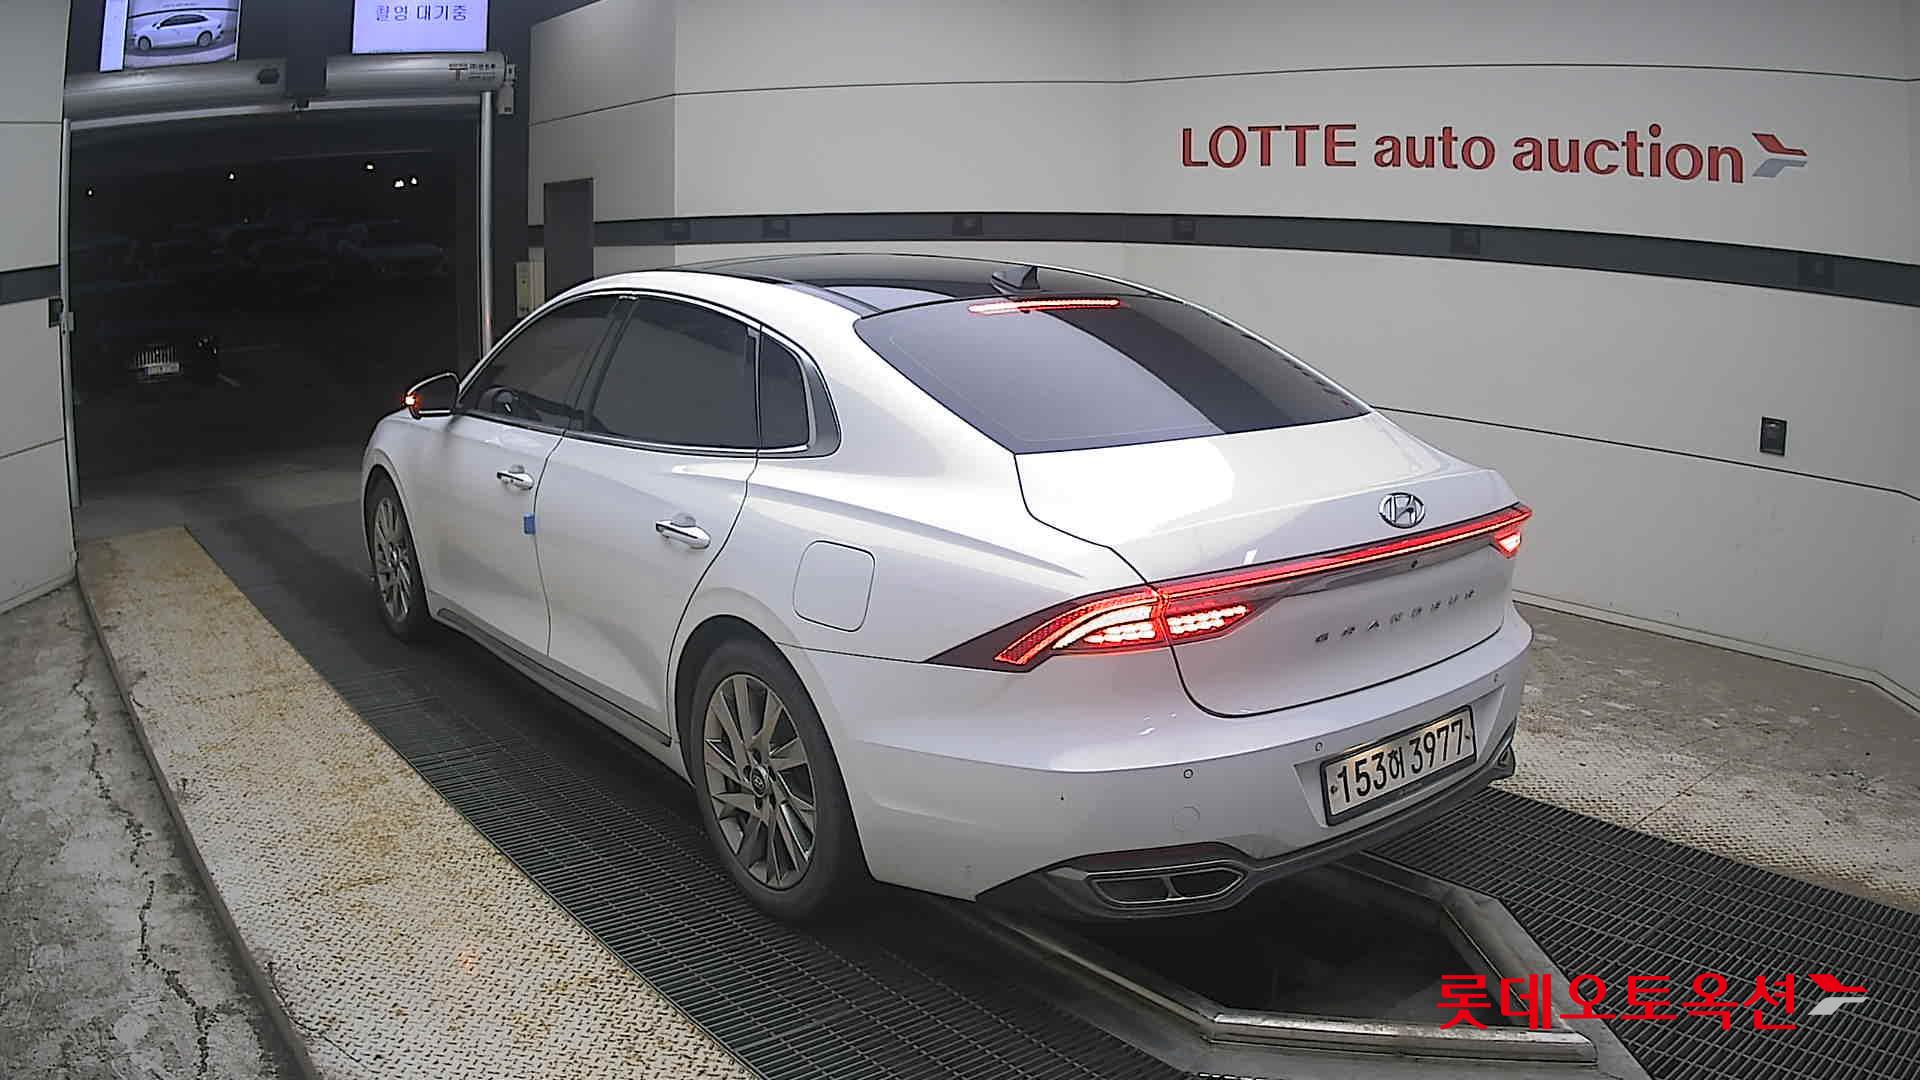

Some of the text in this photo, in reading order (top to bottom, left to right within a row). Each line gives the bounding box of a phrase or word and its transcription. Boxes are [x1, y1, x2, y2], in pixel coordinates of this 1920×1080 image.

[416, 4, 466, 21] 대기중
[1181, 124, 1744, 183] LOTTE auto auction
